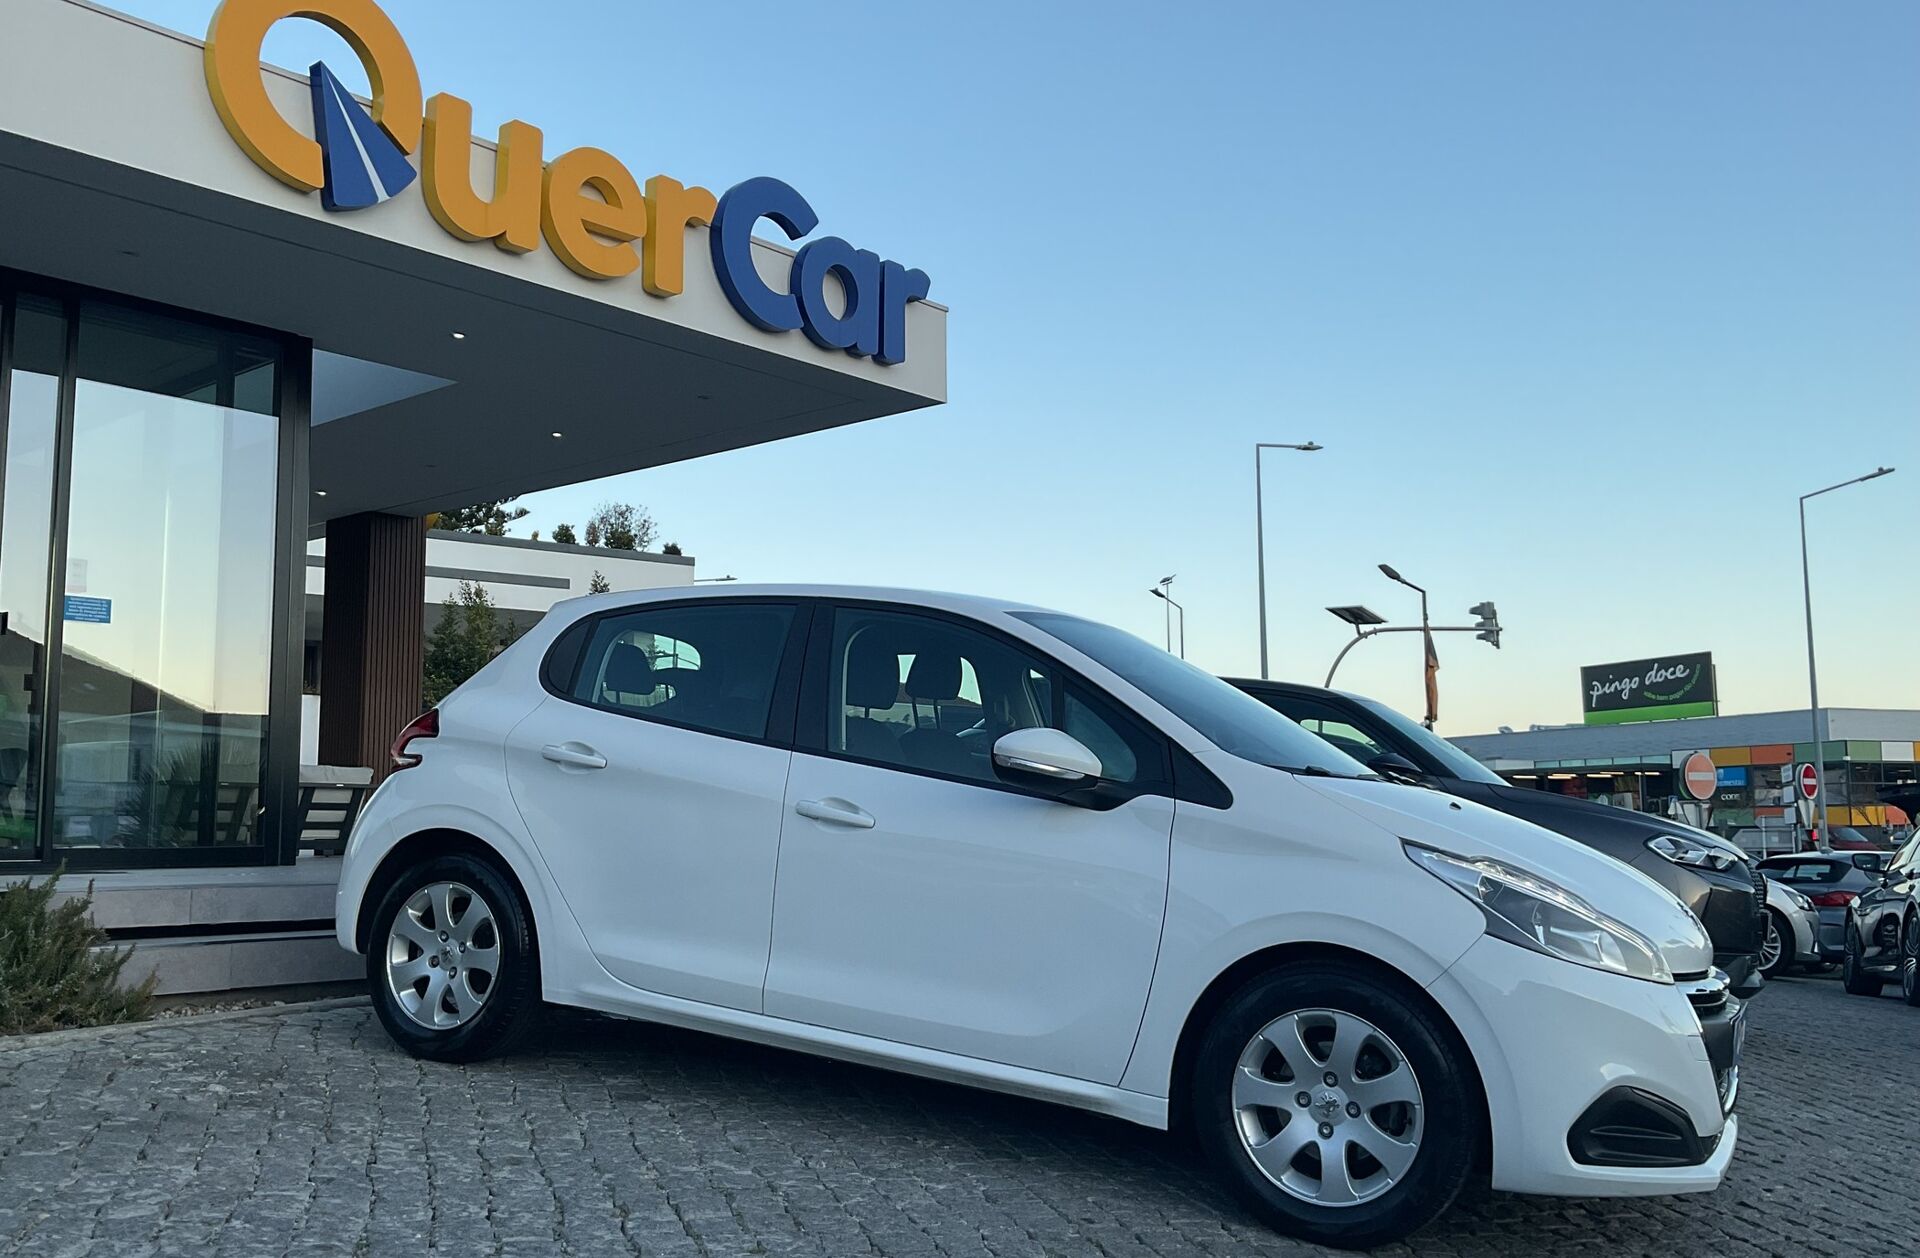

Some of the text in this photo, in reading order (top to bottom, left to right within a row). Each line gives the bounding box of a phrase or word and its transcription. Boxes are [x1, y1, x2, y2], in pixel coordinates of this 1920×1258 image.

[204, 0, 931, 366] QuerCar
[1589, 674, 1639, 708] pingo
[1644, 662, 1690, 685] doce
